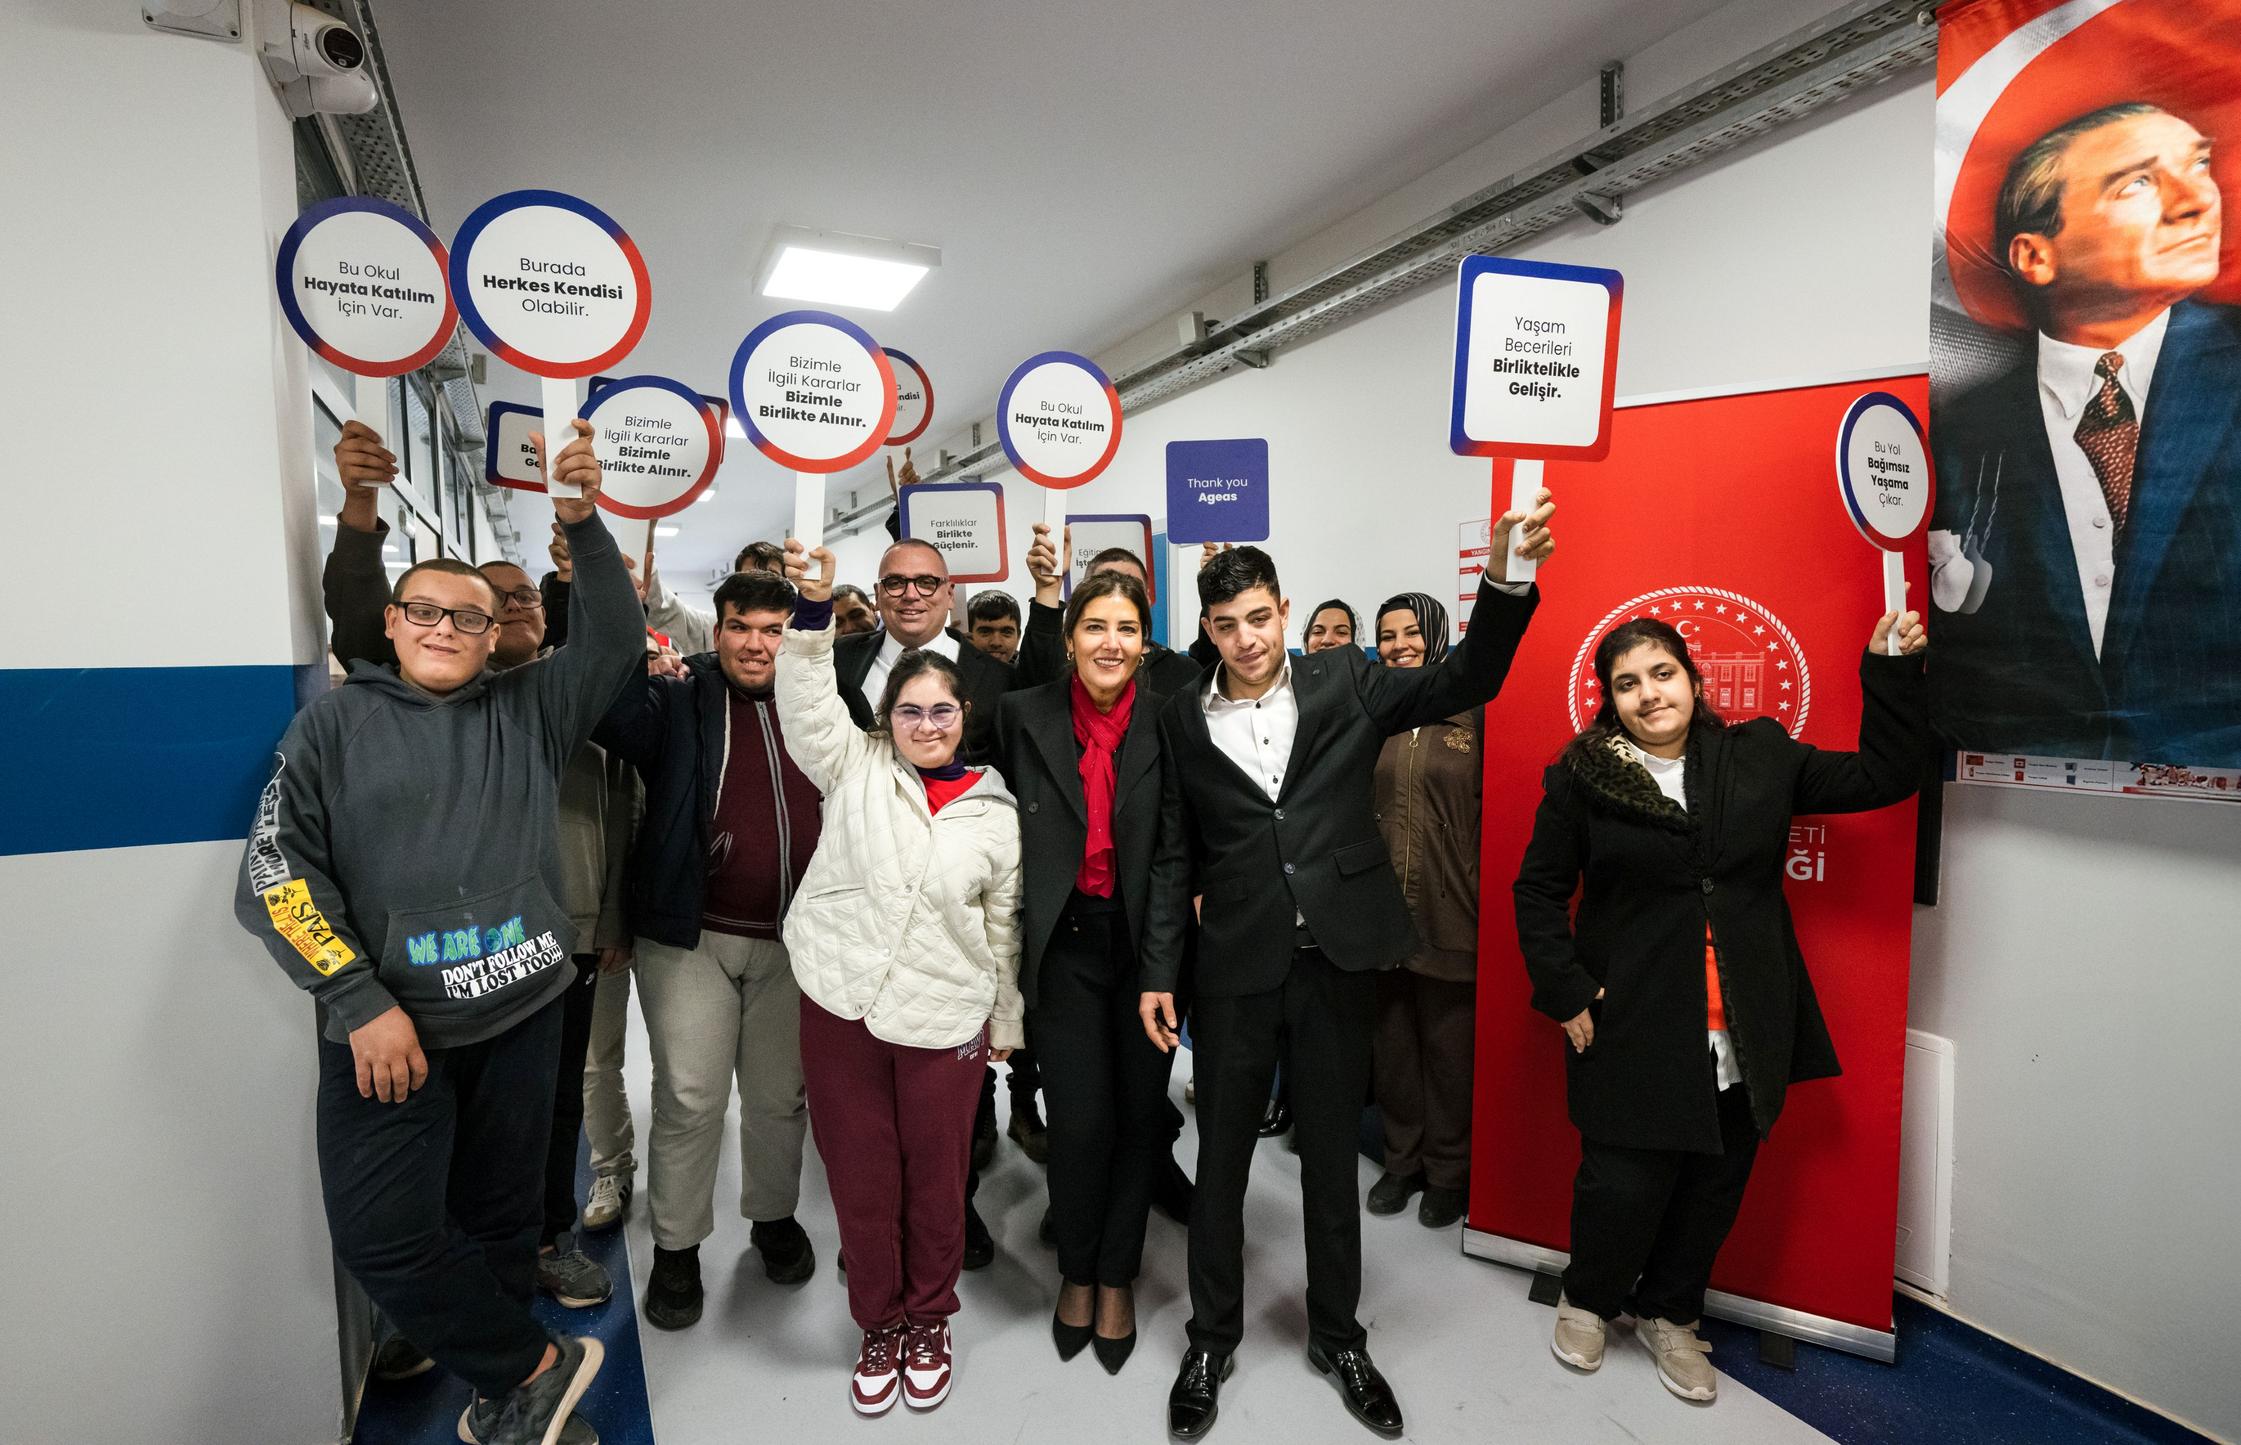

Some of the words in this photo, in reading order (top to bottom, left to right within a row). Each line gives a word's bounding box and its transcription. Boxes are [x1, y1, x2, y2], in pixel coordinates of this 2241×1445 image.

[340, 261, 359, 276] Bu
[364, 264, 400, 280] Okul
[520, 258, 586, 276] Burada
[304, 276, 368, 296] Hayata
[372, 285, 435, 304] Katılım
[483, 274, 550, 293] Herkes
[554, 281, 623, 300] Kendisi
[338, 297, 366, 317] İçin
[371, 304, 402, 319] Var.
[522, 299, 589, 316] Olabilir.
[1514, 316, 1566, 336] Yaşam
[1505, 338, 1572, 356] Becerileri
[790, 356, 842, 372] Bizimle
[1493, 358, 1580, 378] Birliktelikle
[768, 368, 797, 388] İlgili
[802, 375, 861, 392] Kararlar
[786, 390, 843, 407] Bizimle
[898, 392, 920, 400] ndisi
[1509, 382, 1562, 402] Gelişir.
[1040, 400, 1054, 412] Bu
[1058, 402, 1082, 414] Okul
[624, 416, 672, 430] Bizimle
[760, 405, 816, 422] Birlikte
[819, 412, 866, 428] Alınır.
[1015, 413, 1060, 428] Hayata
[1062, 418, 1104, 432] Katılım
[604, 428, 631, 444] İlgili
[634, 432, 689, 446] Kararlar
[1037, 428, 1057, 444] İçin
[1060, 432, 1082, 444] Var.
[618, 446, 670, 460] Bizimle
[1874, 441, 1886, 453] Bu
[1888, 444, 1900, 456] Yol
[648, 464, 692, 478] Alınır.
[1868, 456, 1910, 474] Bağımsız
[1187, 478, 1223, 488] Thank
[1226, 479, 1248, 490] you
[1870, 474, 1909, 491] Yaşama
[1198, 492, 1238, 504] Ageas
[1878, 492, 1904, 508] Çıkar.
[936, 530, 972, 538] Birlikte
[933, 540, 978, 552] Güçlenir.
[408, 932, 439, 964] WE
[442, 926, 482, 961] ARE
[440, 962, 486, 986] DON'T
[488, 938, 540, 969] FOLLOW
[536, 930, 557, 950] ME
[447, 984, 473, 998] I'M
[476, 966, 518, 994] LOST
[520, 946, 564, 976] TOO!!!
